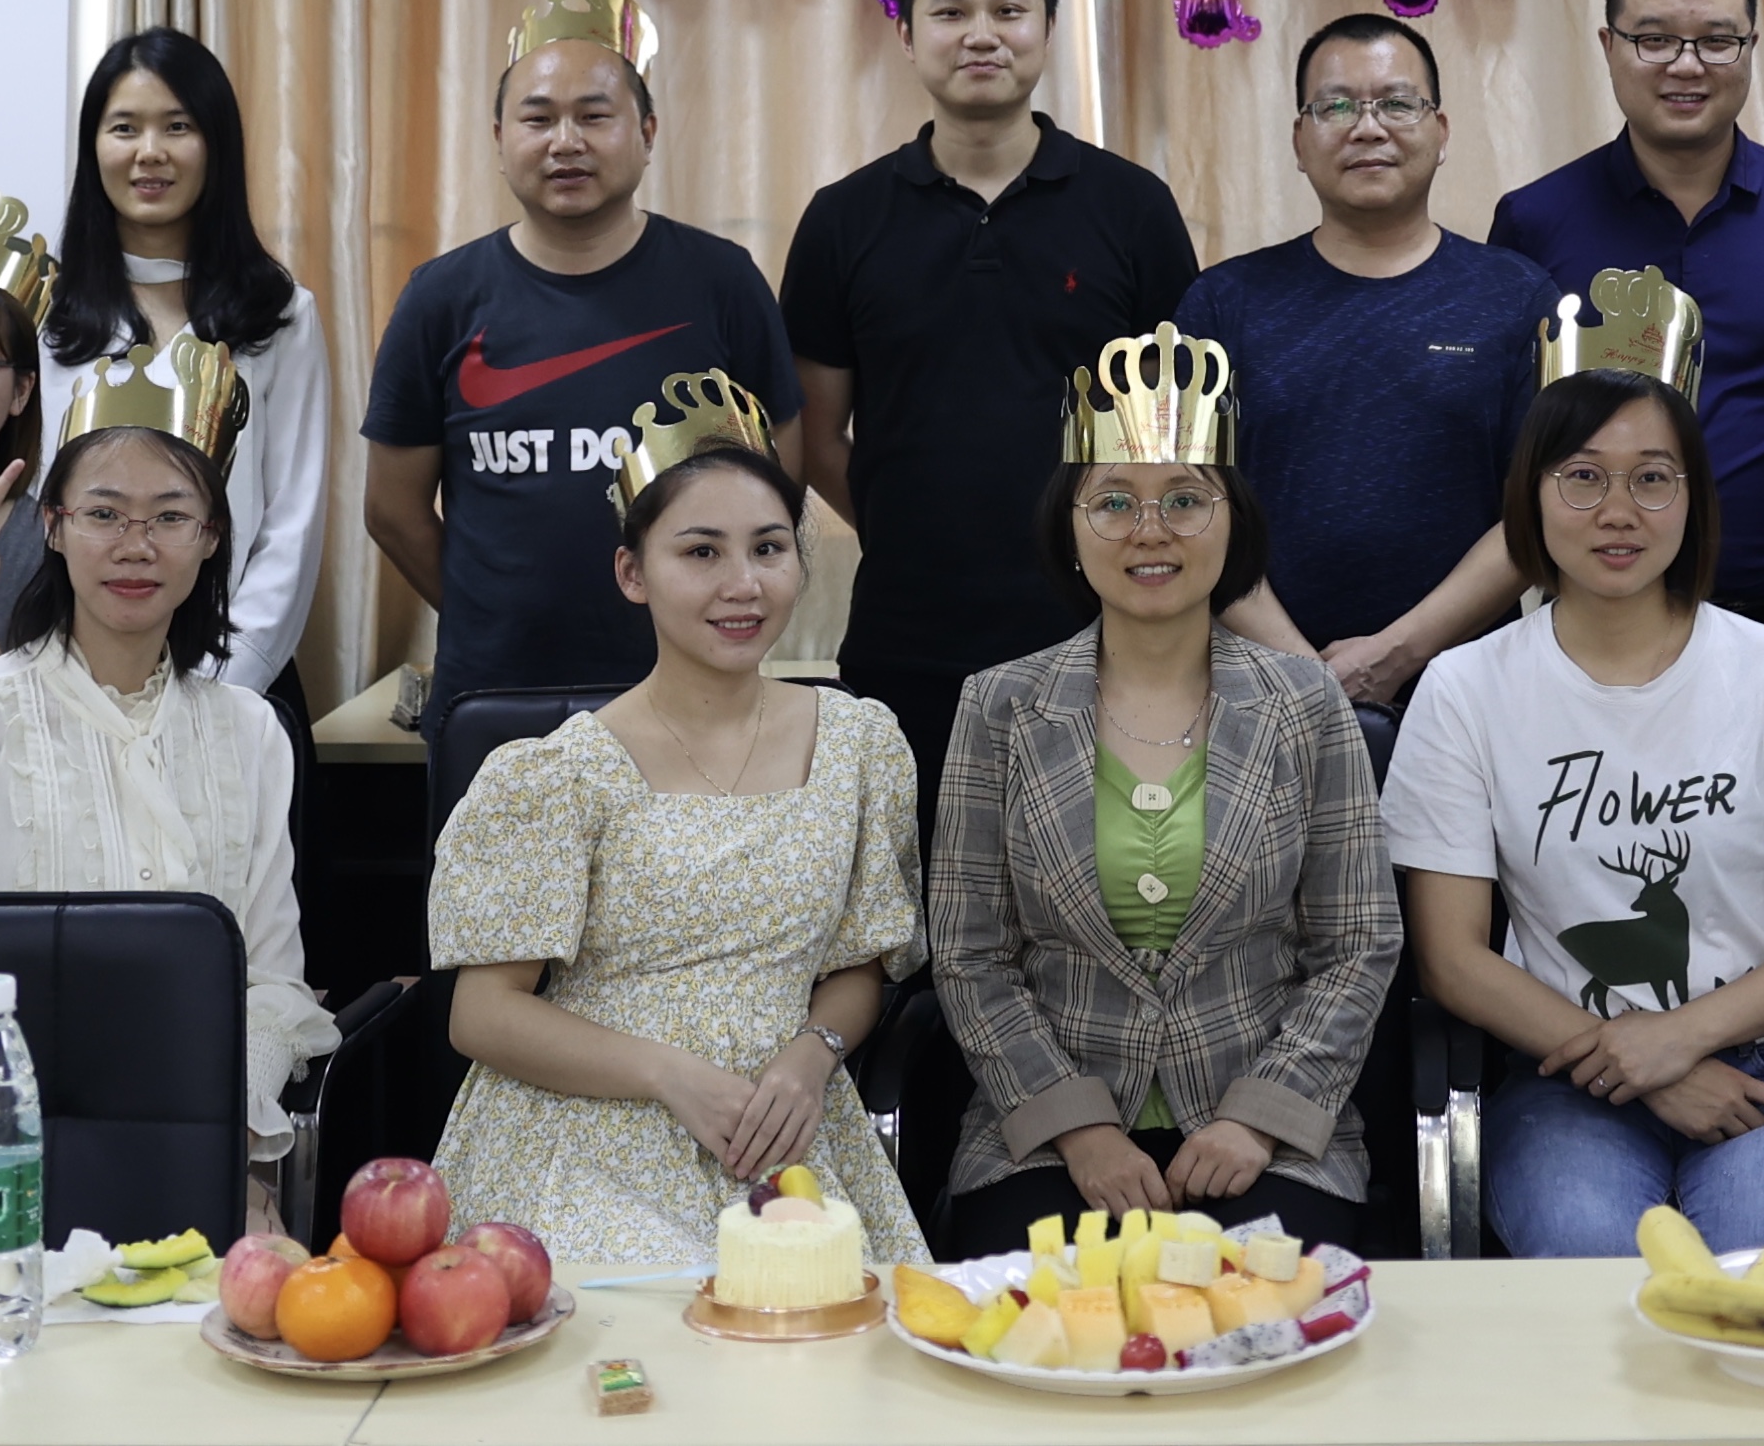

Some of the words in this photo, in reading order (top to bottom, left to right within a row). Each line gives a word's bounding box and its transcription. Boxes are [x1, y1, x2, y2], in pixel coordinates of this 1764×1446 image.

[1600, 348, 1646, 365] Happy
[469, 429, 554, 474] JUST
[571, 426, 633, 472] DO
